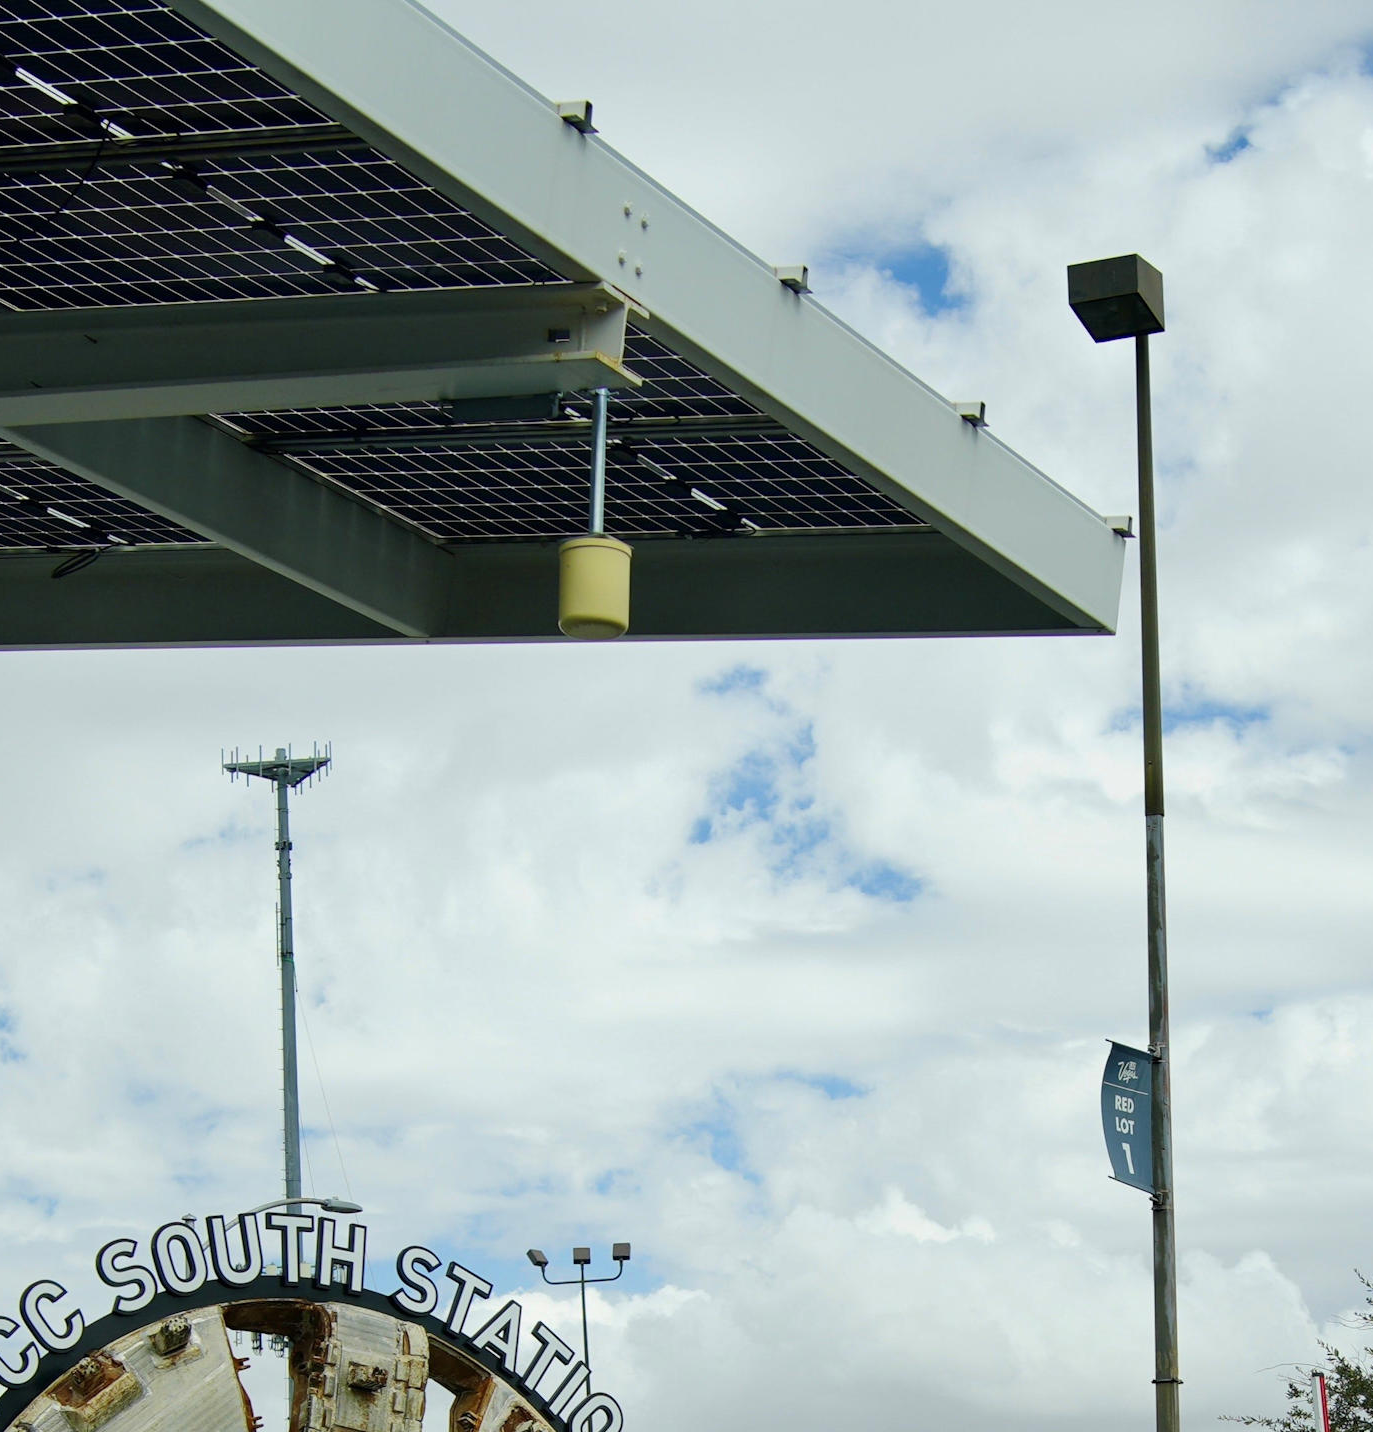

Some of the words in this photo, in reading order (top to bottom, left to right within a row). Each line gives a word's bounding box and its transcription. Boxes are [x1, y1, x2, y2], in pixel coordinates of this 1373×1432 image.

[1114, 1095, 1135, 1114] RED
[1115, 1117, 1135, 1135] LOT
[1121, 1142, 1135, 1175] 1
[96, 1211, 367, 1315] SOUTH
